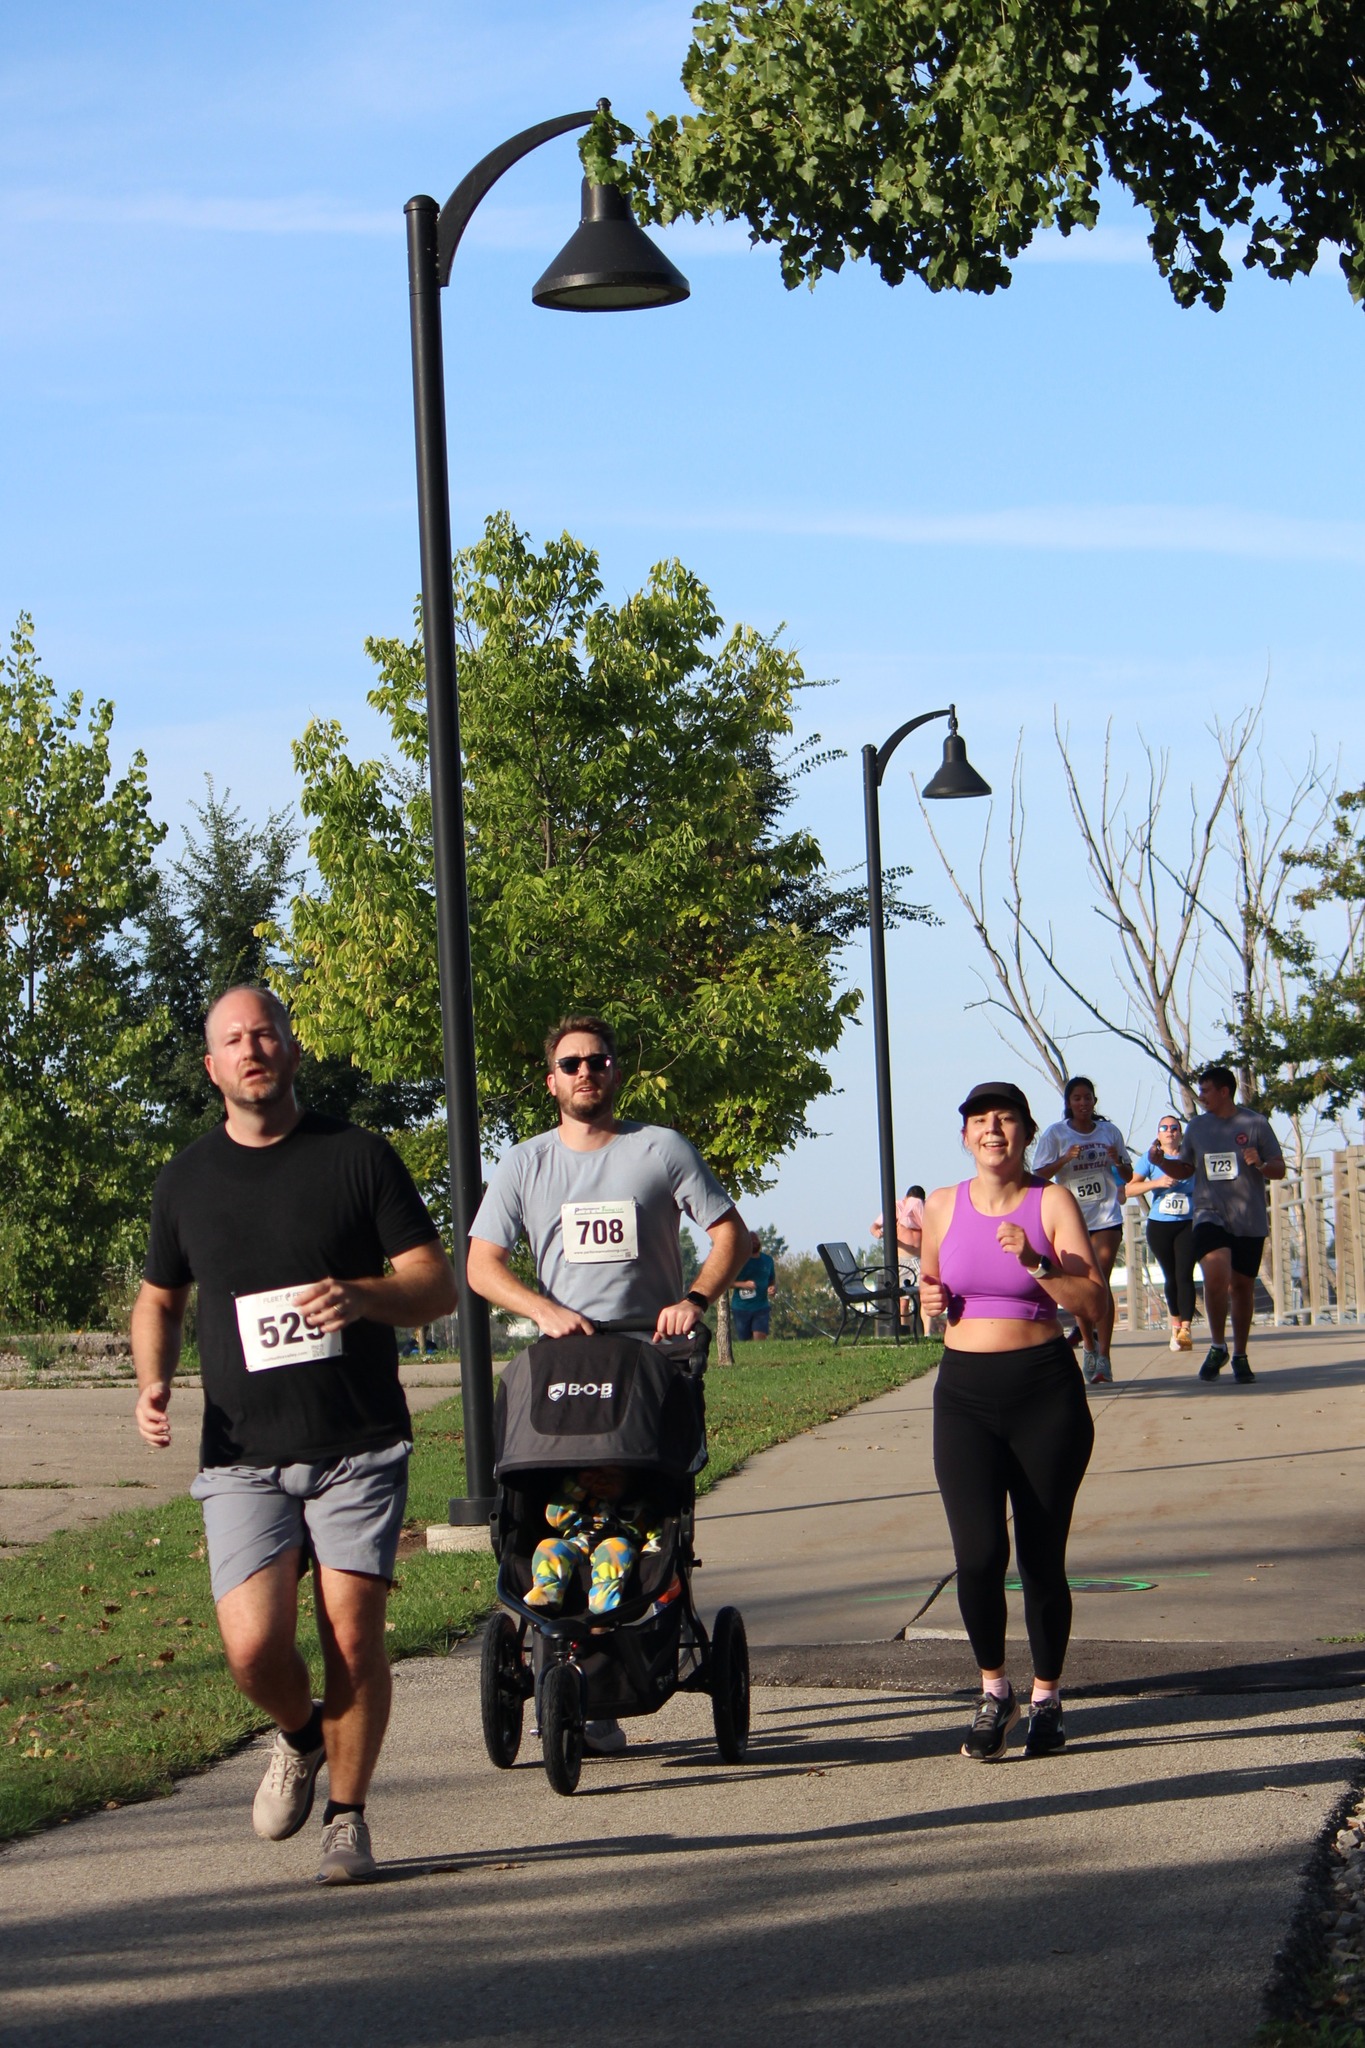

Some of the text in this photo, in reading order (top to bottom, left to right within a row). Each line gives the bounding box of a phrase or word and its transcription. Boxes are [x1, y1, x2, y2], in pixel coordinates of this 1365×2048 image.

[1210, 1160, 1232, 1172] 723
[1077, 1182, 1101, 1197] 520
[1165, 1199, 1184, 1209] 507
[576, 1218, 624, 1245] 708
[263, 1294, 283, 1304] FLEET
